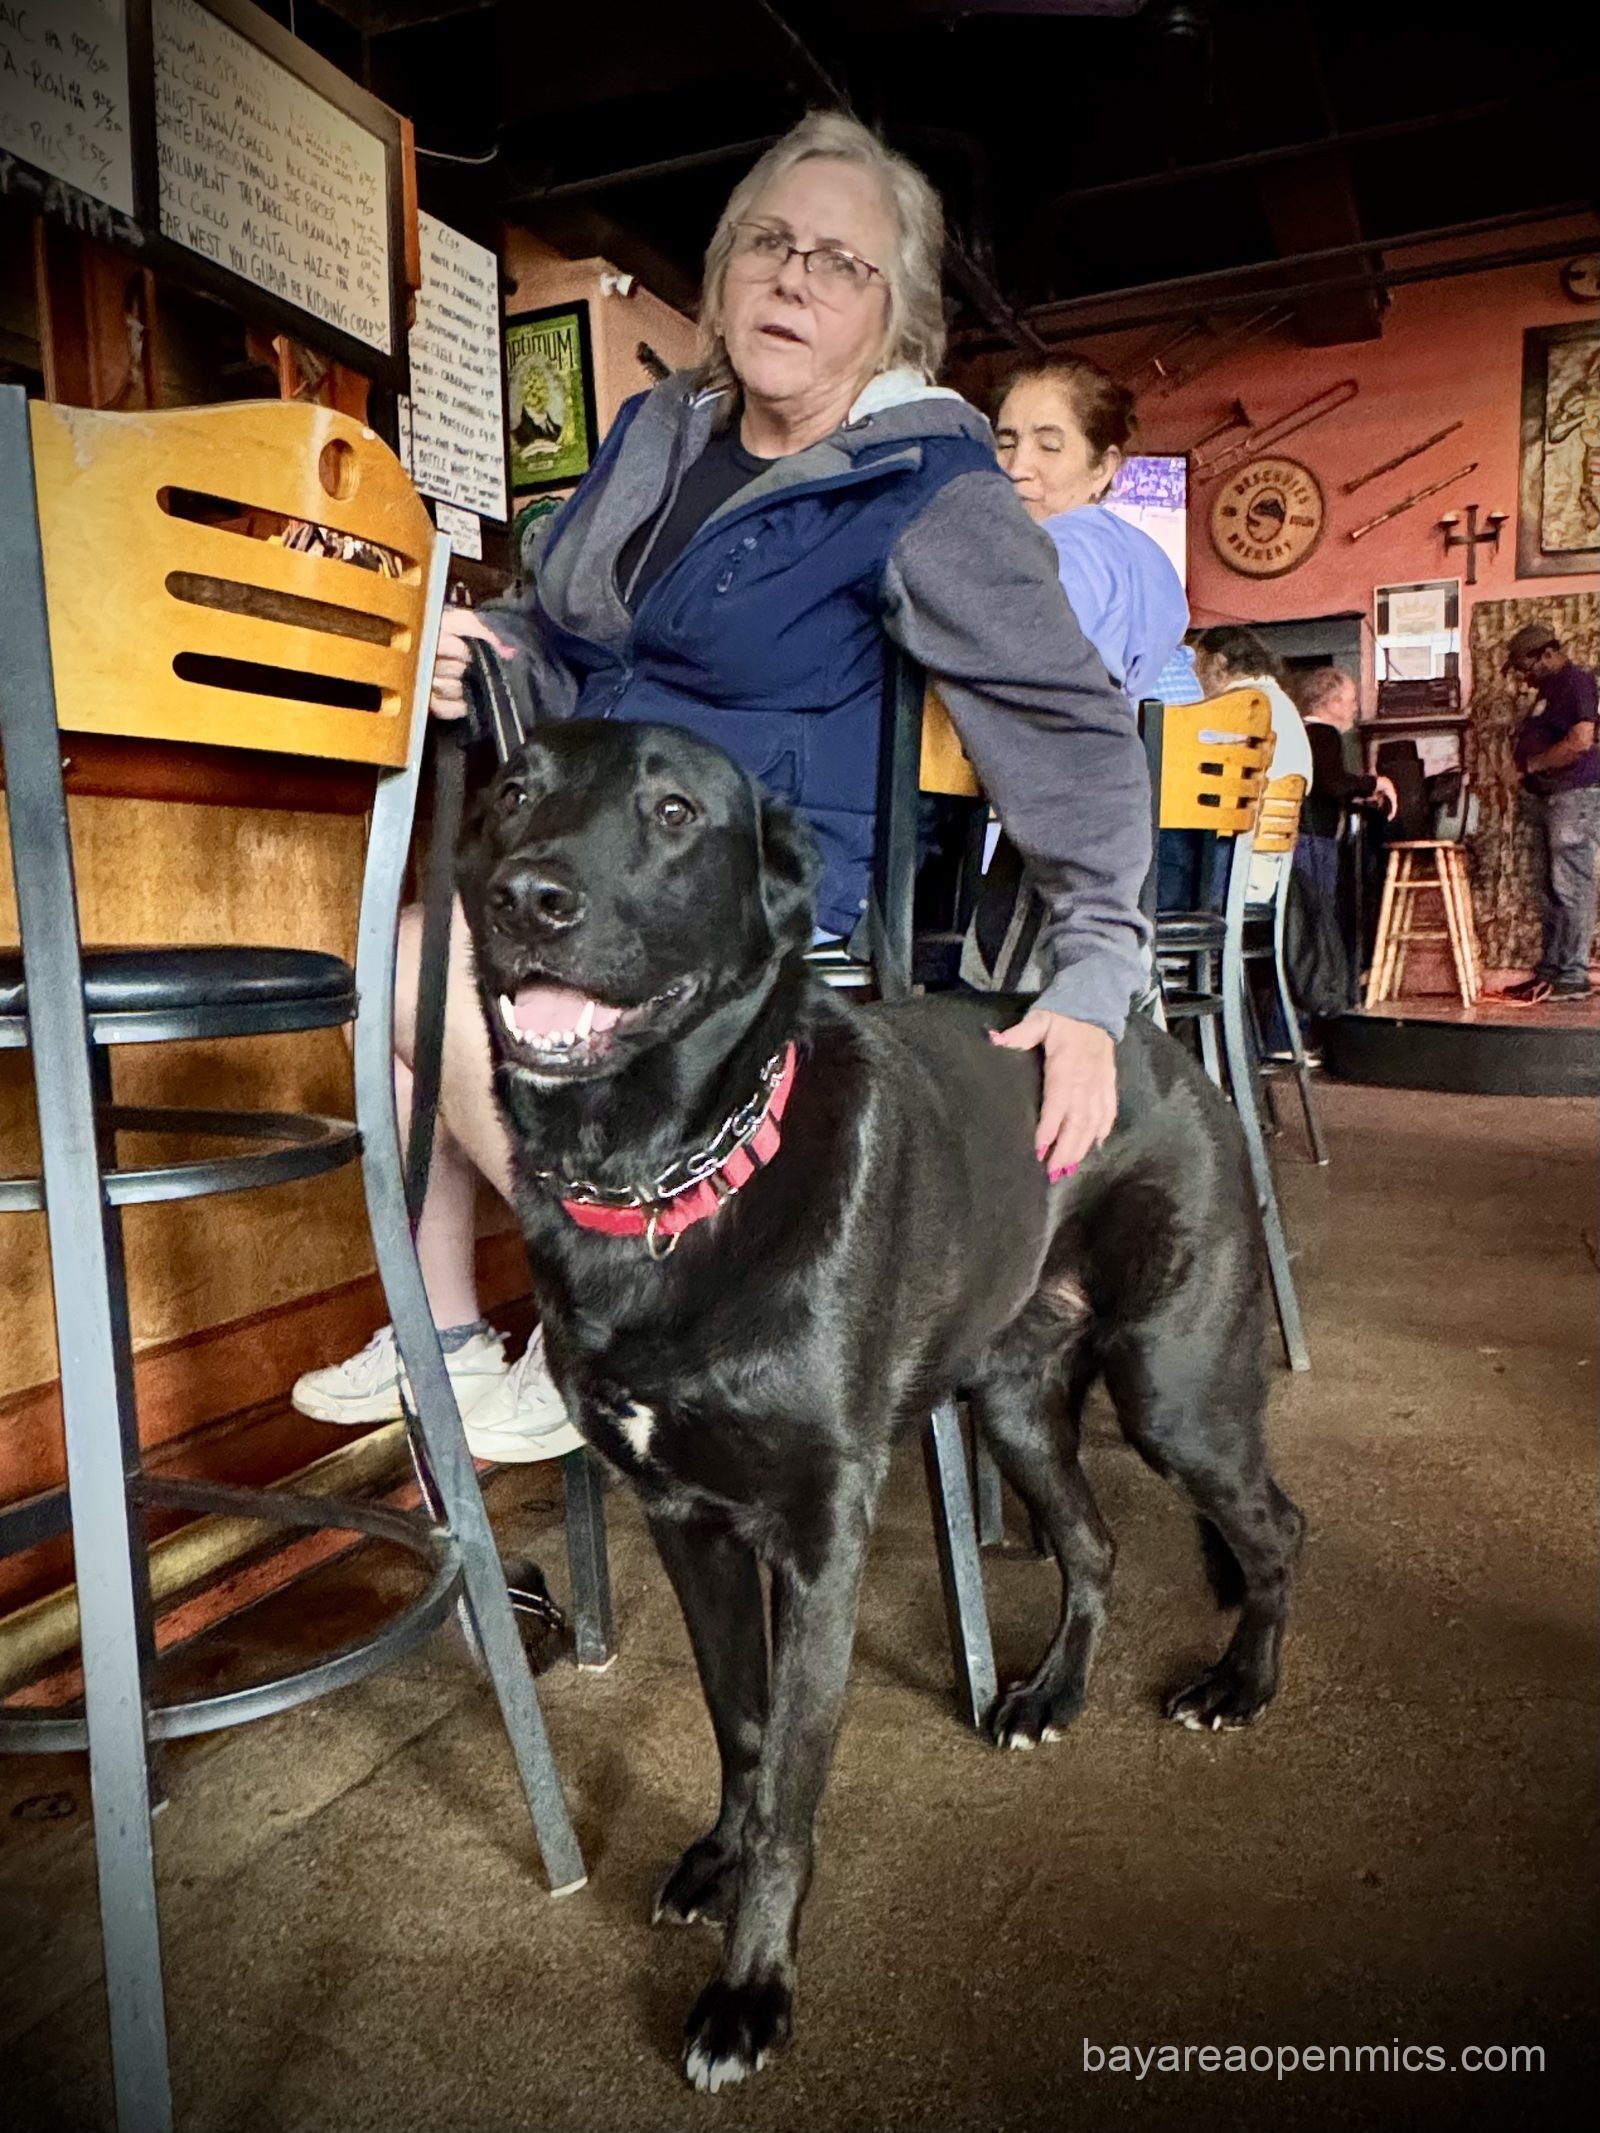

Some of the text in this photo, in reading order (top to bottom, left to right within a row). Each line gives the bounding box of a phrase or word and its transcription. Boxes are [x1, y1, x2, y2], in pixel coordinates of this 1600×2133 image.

[186, 221, 222, 260] WEST
[241, 217, 299, 267] MENTAL
[303, 249, 333, 281] HAZE
